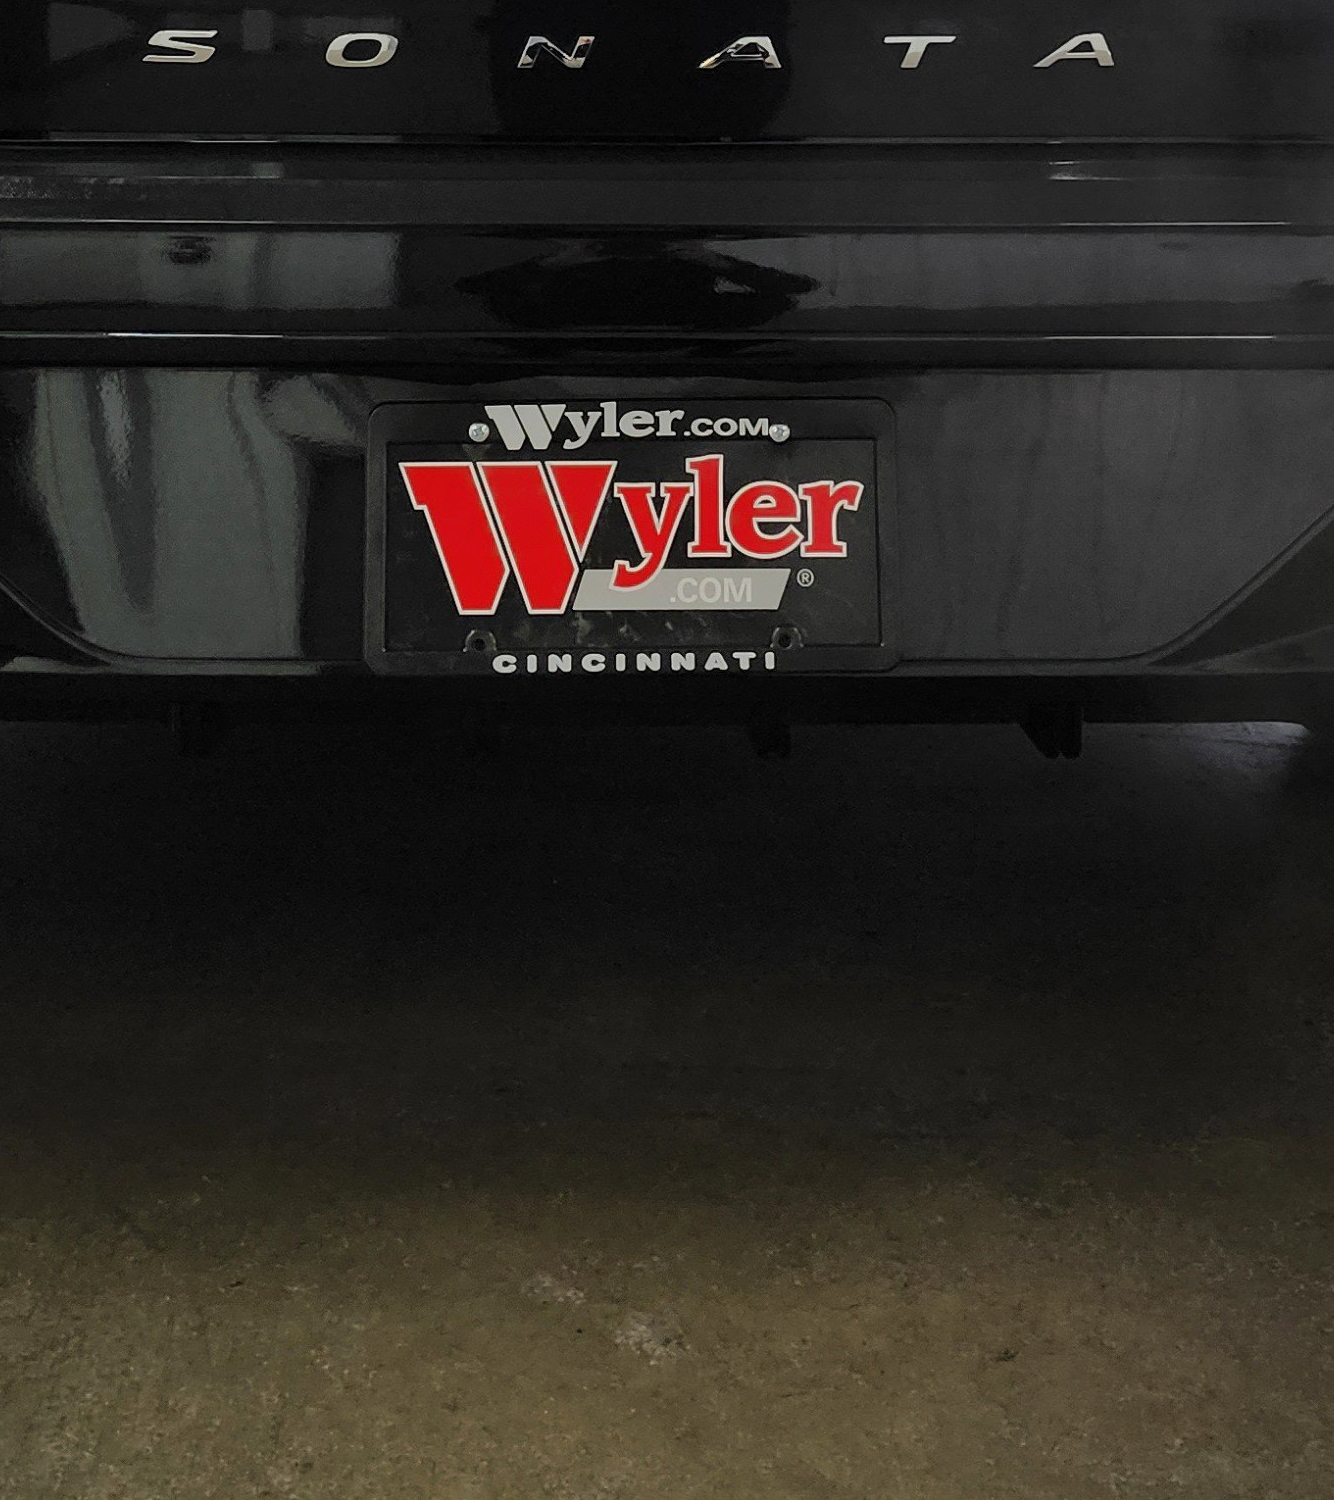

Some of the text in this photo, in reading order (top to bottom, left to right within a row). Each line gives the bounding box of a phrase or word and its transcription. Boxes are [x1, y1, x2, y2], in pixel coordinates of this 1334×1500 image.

[142, 29, 1115, 69] SONATA
[398, 454, 864, 615] Wyler
[492, 651, 776, 673] CINCINNATI
